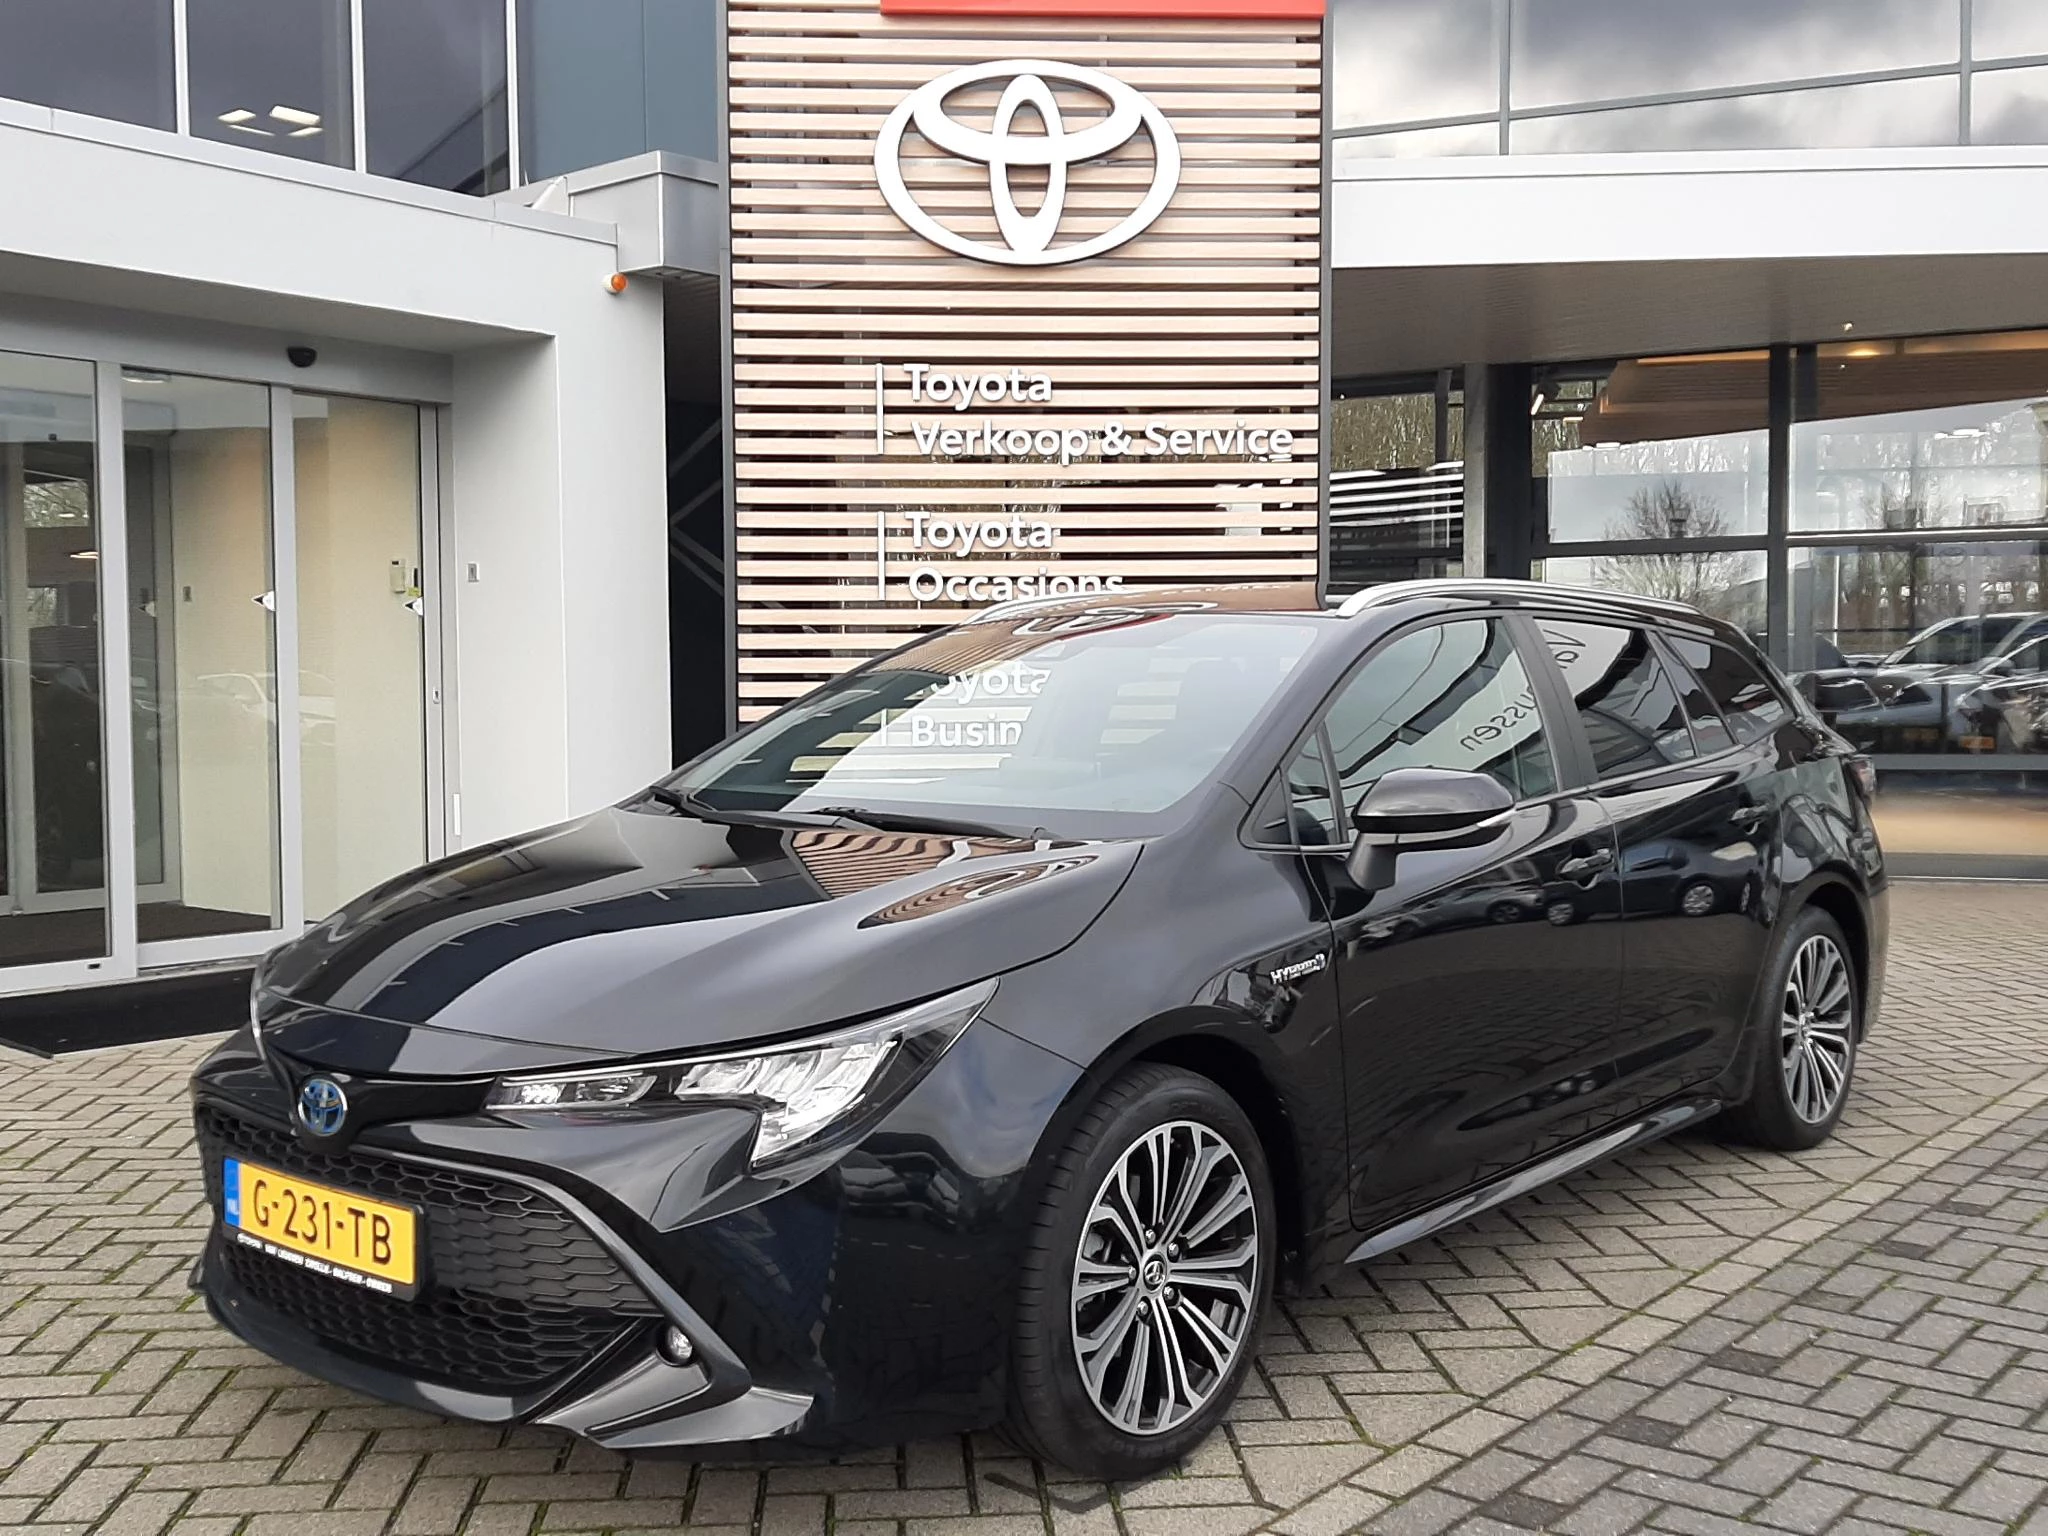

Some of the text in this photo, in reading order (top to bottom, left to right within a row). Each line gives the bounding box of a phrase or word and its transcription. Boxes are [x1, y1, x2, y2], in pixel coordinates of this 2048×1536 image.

[903, 363, 1053, 411] Toyota
[911, 419, 1294, 466] Verkoop & Service
[903, 511, 1053, 557] Toyota
[908, 567, 1124, 601] Occasions
[918, 661, 1051, 706] oyota
[910, 713, 1023, 748] Busin
[253, 1179, 392, 1266] G-231-TB
